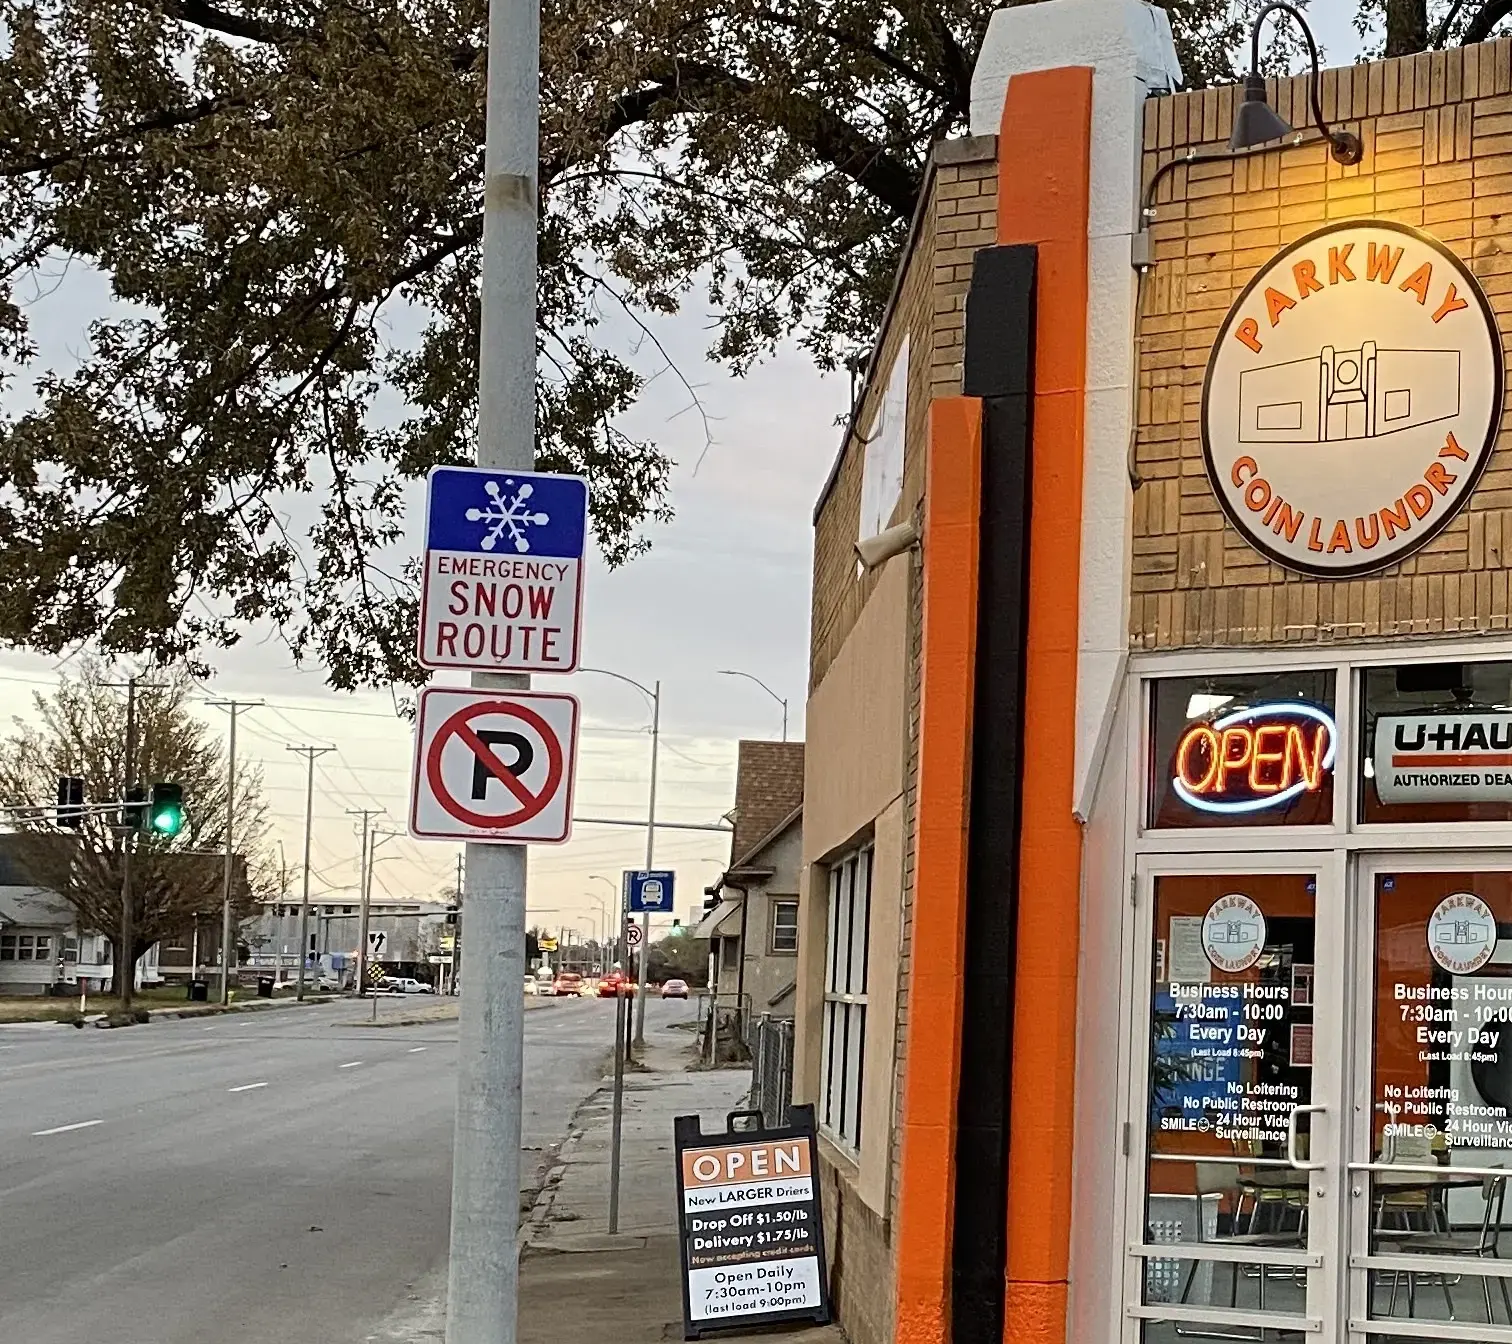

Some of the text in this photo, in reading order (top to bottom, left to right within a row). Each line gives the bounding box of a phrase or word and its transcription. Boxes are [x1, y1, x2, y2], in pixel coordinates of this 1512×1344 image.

[1235, 242, 1468, 353] PARKWAY
[1231, 431, 1469, 553] COIN LAUNDRY
[437, 557, 569, 582] EMERGENCY
[448, 580, 554, 621] SNOW
[436, 623, 561, 662] ROUTE
[1176, 724, 1324, 793] OPEN
[1393, 773, 1481, 787] AUTHORIZED
[1209, 896, 1261, 921] PARKWAY
[1435, 896, 1491, 921] PARKWAY
[1225, 943, 1260, 969] LAUNDRY
[1453, 944, 1491, 971] LAUNDRY
[1169, 983, 1289, 999] Business Hours
[1394, 983, 1469, 1000] Business
[1174, 1004, 1228, 1019] 7:30am
[1243, 1004, 1284, 1020] 10:00
[1399, 1005, 1458, 1022] 7:30am
[1189, 1024, 1266, 1045] Every Day
[1416, 1026, 1500, 1048] Every Day
[1191, 1048, 1211, 1058] (Last
[1212, 1048, 1232, 1057] Load
[1418, 1051, 1440, 1062] (Last
[1441, 1052, 1463, 1061] Load
[1227, 1082, 1298, 1098] No Loitering
[1384, 1085, 1459, 1101] No Loitering
[1183, 1096, 1298, 1111] No Public Restroom
[1384, 1101, 1507, 1117] No Public Restroom
[1161, 1118, 1197, 1130] SMILE
[1216, 1113, 1230, 1125] 24
[1232, 1114, 1262, 1126] Hour
[1444, 1119, 1459, 1132] 24
[1463, 1120, 1494, 1133] Hour
[1215, 1127, 1286, 1141] Surveillance
[1384, 1125, 1423, 1137] SMILE
[692, 1145, 801, 1182] OPEN
[688, 1186, 810, 1207] New LARGER Driers
[692, 1209, 808, 1232] Drop Off $1.50/lb
[693, 1228, 809, 1250] Delivery $1.75/lb
[692, 1255, 715, 1264] Now
[716, 1249, 761, 1262] accepting
[789, 1244, 814, 1253] cards
[715, 1265, 794, 1285] Open Daily
[705, 1280, 806, 1300] 7:30am-10pm
[705, 1294, 807, 1315] (last load 9:00pm)
